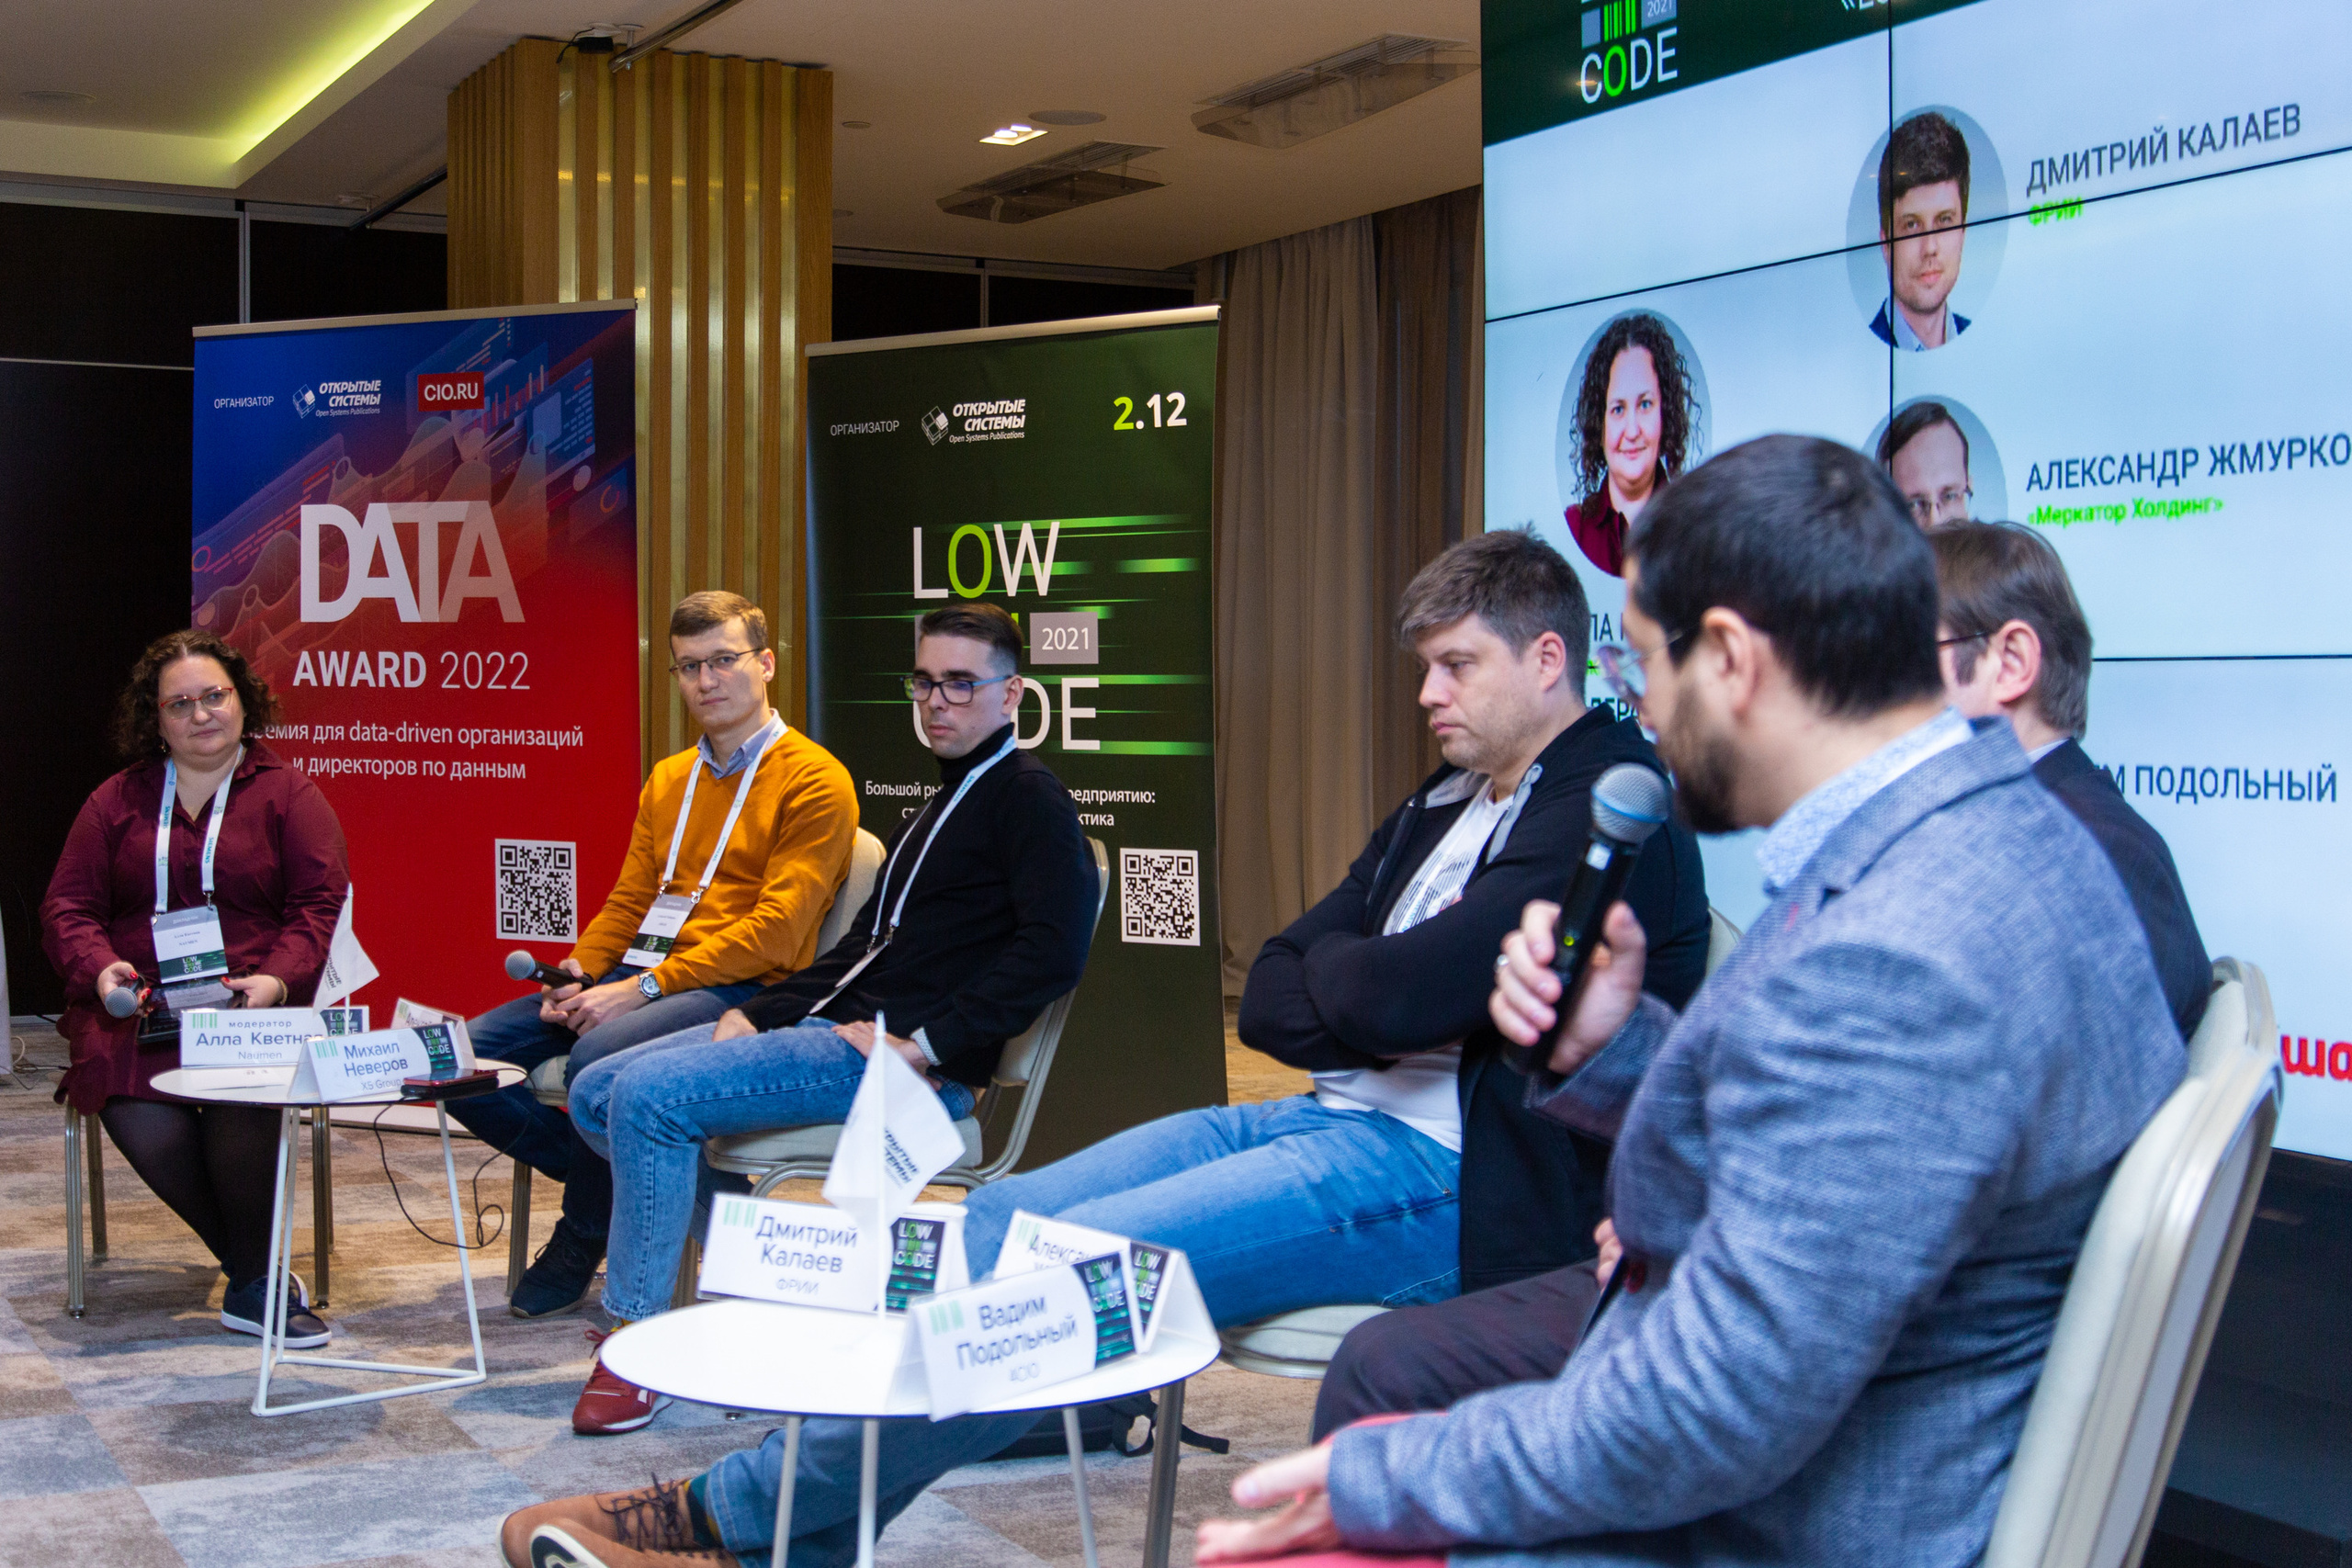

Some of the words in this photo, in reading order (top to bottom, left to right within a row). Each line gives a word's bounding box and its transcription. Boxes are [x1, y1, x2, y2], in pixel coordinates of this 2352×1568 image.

[1580, 27, 1679, 104] CODE
[2026, 125, 2168, 197] ДМИТРИЙ
[2177, 103, 2301, 161] КАЛАЕВ
[319, 379, 382, 395] ОТКРЫТЫЕ
[424, 382, 479, 401] CIO.RU
[214, 396, 275, 410] ОРГАНИЗАТОР
[329, 393, 381, 408] СИСТЕМЫ
[952, 399, 1026, 418] ОТКРЫТЫЕ
[315, 409, 328, 418] Open
[329, 408, 349, 417] Systems
[349, 407, 380, 416] Publications
[1113, 392, 1188, 431] 2.12
[830, 420, 900, 436] ОРГАНИЗАТОР
[964, 414, 1026, 432] СИСТЕМЫ
[949, 434, 965, 444] Open
[966, 433, 989, 444] Systems
[989, 430, 1025, 440] Publications
[2025, 447, 2200, 492] АЛЕКСАНДР
[2208, 433, 2352, 478] ЖМУРКО
[300, 500, 526, 624] DATA
[912, 521, 1060, 599] LOW
[1041, 626, 1091, 651] 2021
[292, 650, 427, 688] AWARD
[439, 650, 532, 690] 2022
[242, 724, 309, 740] емия
[313, 725, 345, 744] для
[349, 720, 453, 744] data-driven
[458, 725, 583, 750] организаций
[293, 757, 303, 773] и
[307, 758, 417, 781] директоров
[423, 761, 447, 777] по
[449, 761, 526, 782] данным
[865, 781, 922, 796] Большой
[1068, 789, 1156, 806] едприятию:
[2134, 763, 2338, 805] ПОДОЛЬНЫЙ
[1077, 813, 1115, 827] ктика
[184, 965, 203, 974] CODE
[229, 1021, 292, 1029] модератор
[423, 1029, 443, 1039] LOW
[196, 1032, 242, 1046] Алла
[427, 1043, 452, 1055] CODE
[238, 1051, 283, 1060] Naumen
[344, 1043, 401, 1060] Михаил
[344, 1058, 409, 1078] Неверов
[361, 1081, 375, 1090] X5
[375, 1077, 401, 1090] Group
[755, 1215, 858, 1248] Дмитрий
[898, 1220, 934, 1240] LOW
[760, 1243, 843, 1273] Калаев
[894, 1250, 935, 1269] CODE
[1134, 1248, 1162, 1269] LOW
[1084, 1258, 1114, 1283] LOW
[1091, 1290, 1125, 1313] CODE
[978, 1295, 1047, 1331] Вадим
[956, 1314, 1079, 1371] Подольный
